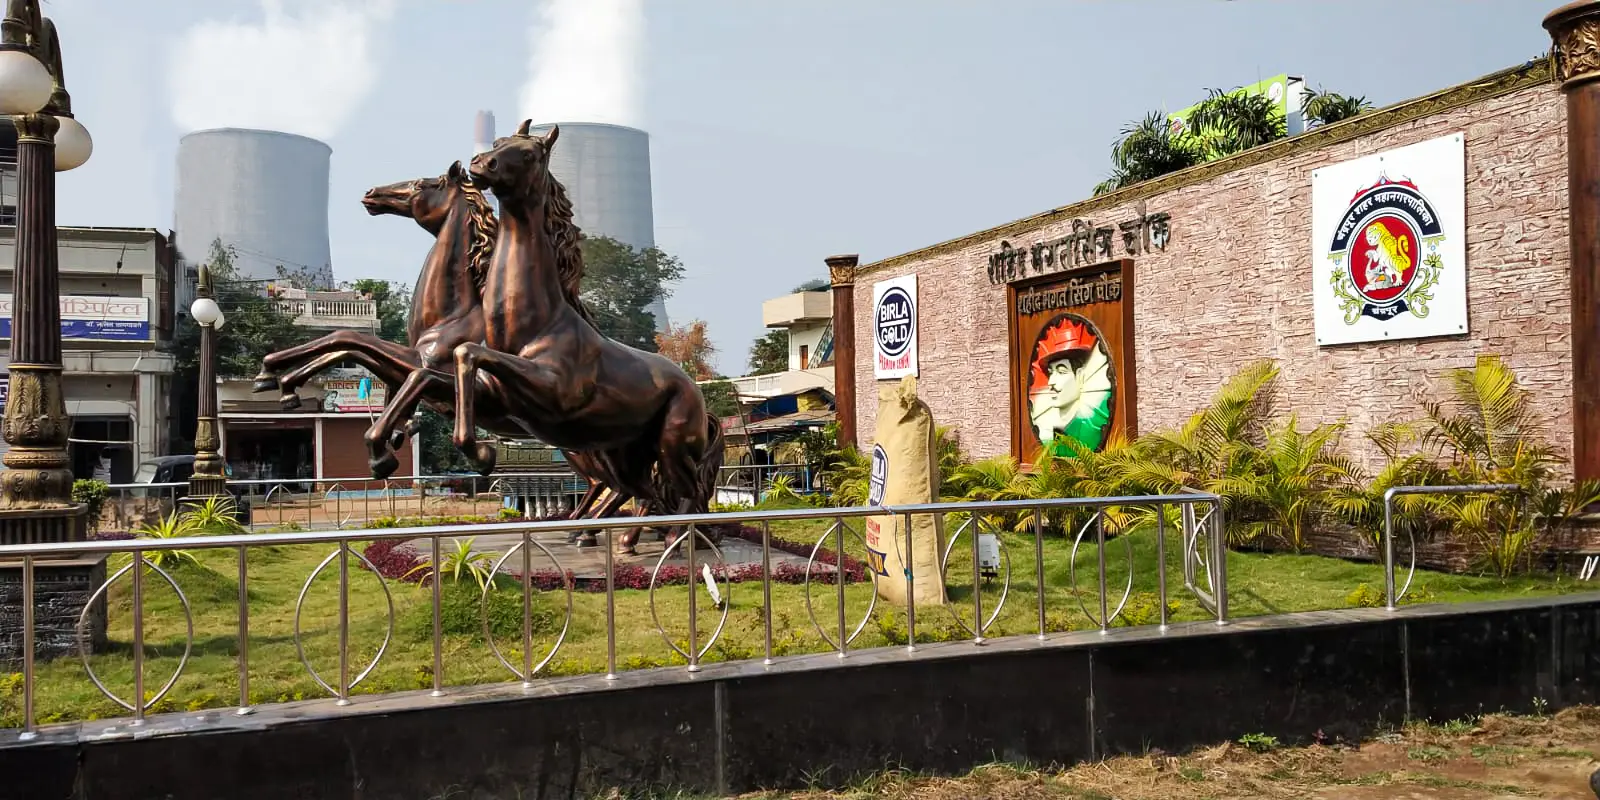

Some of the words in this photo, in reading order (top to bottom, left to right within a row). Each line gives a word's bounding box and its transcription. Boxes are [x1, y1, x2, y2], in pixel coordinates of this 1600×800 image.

[1353, 196, 1374, 215] शहर
[1374, 191, 1434, 226] महानगरपालिका
[881, 301, 909, 321] BIRLA
[881, 325, 908, 345] GOLD
